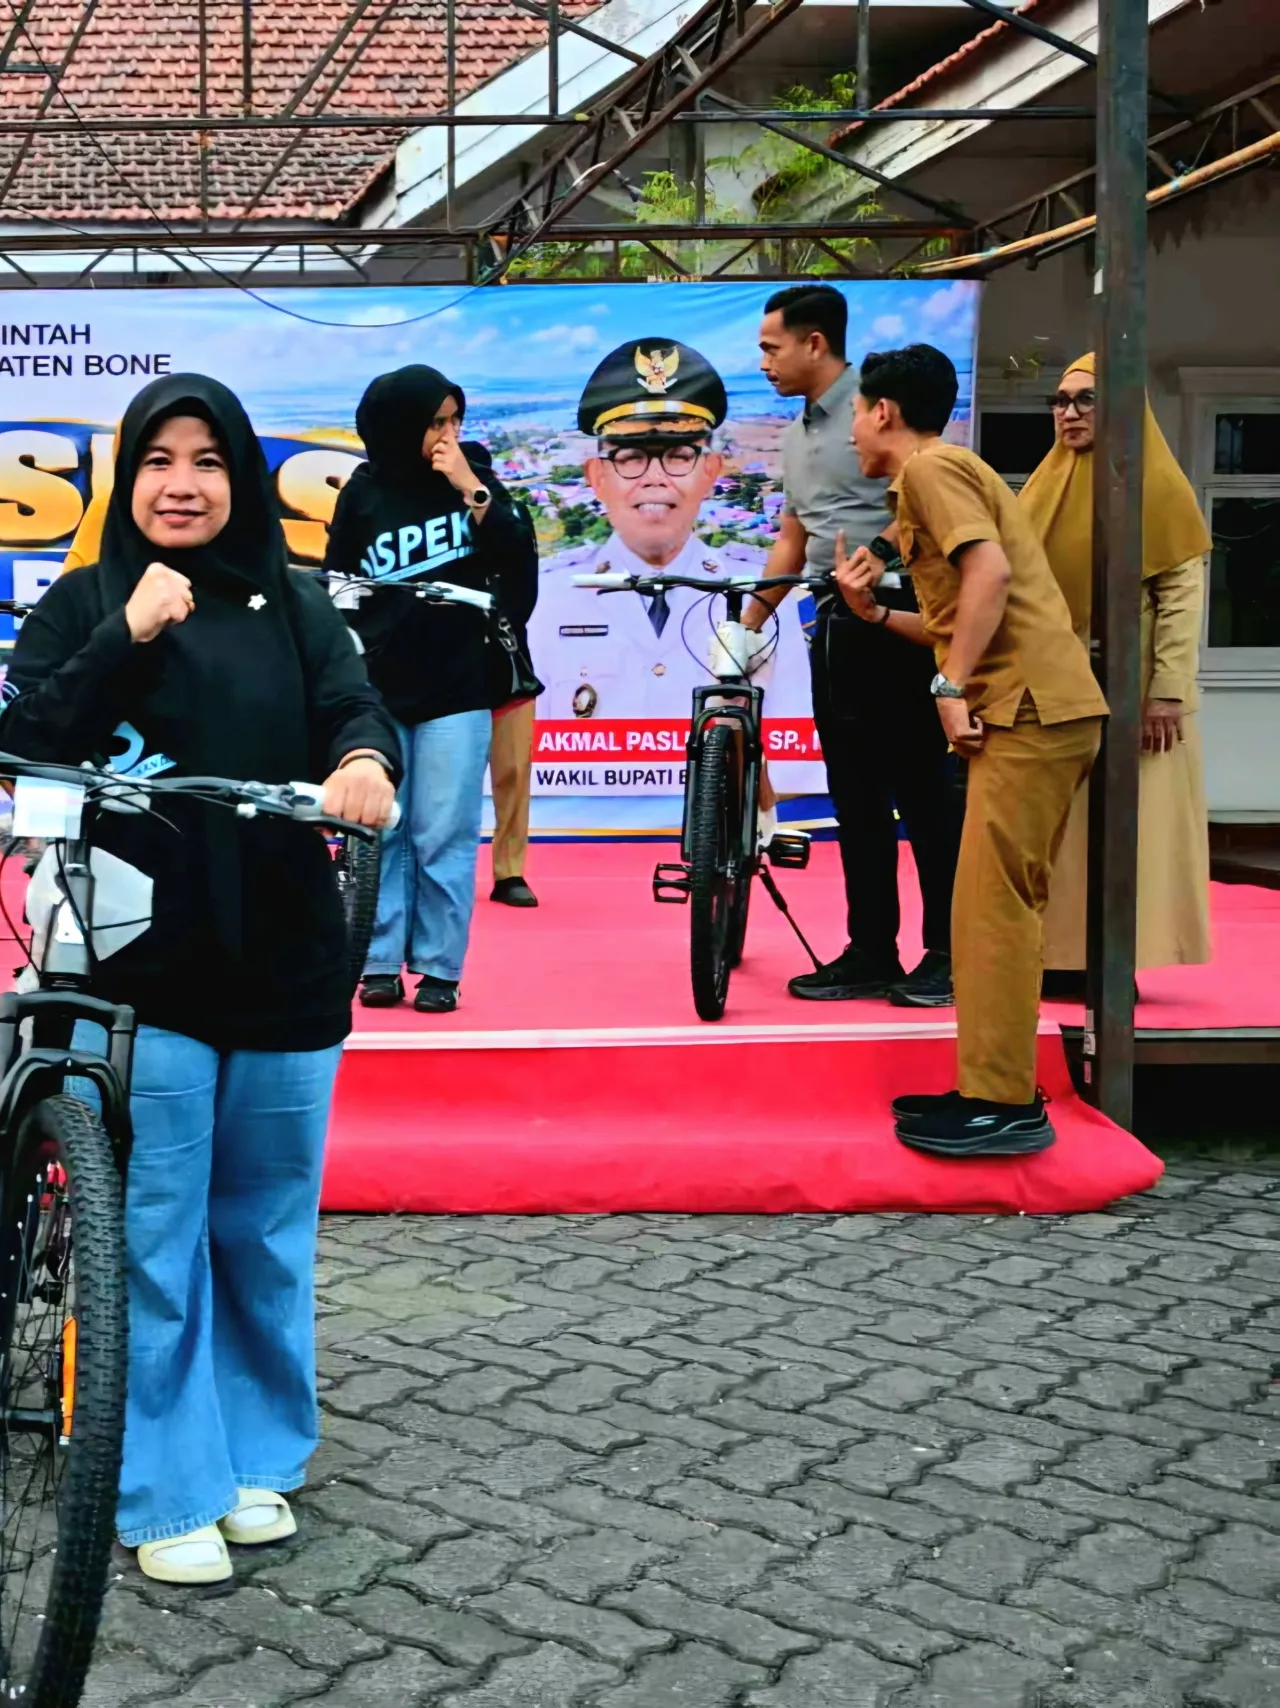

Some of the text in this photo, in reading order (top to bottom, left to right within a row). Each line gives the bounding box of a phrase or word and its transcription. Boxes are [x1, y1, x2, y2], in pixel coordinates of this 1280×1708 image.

[83, 353, 172, 376] BONE
[537, 731, 622, 752] AKMAL
[625, 731, 691, 752] PASL
[536, 769, 599, 786] WAKIL
[604, 769, 673, 786] BUPATI
